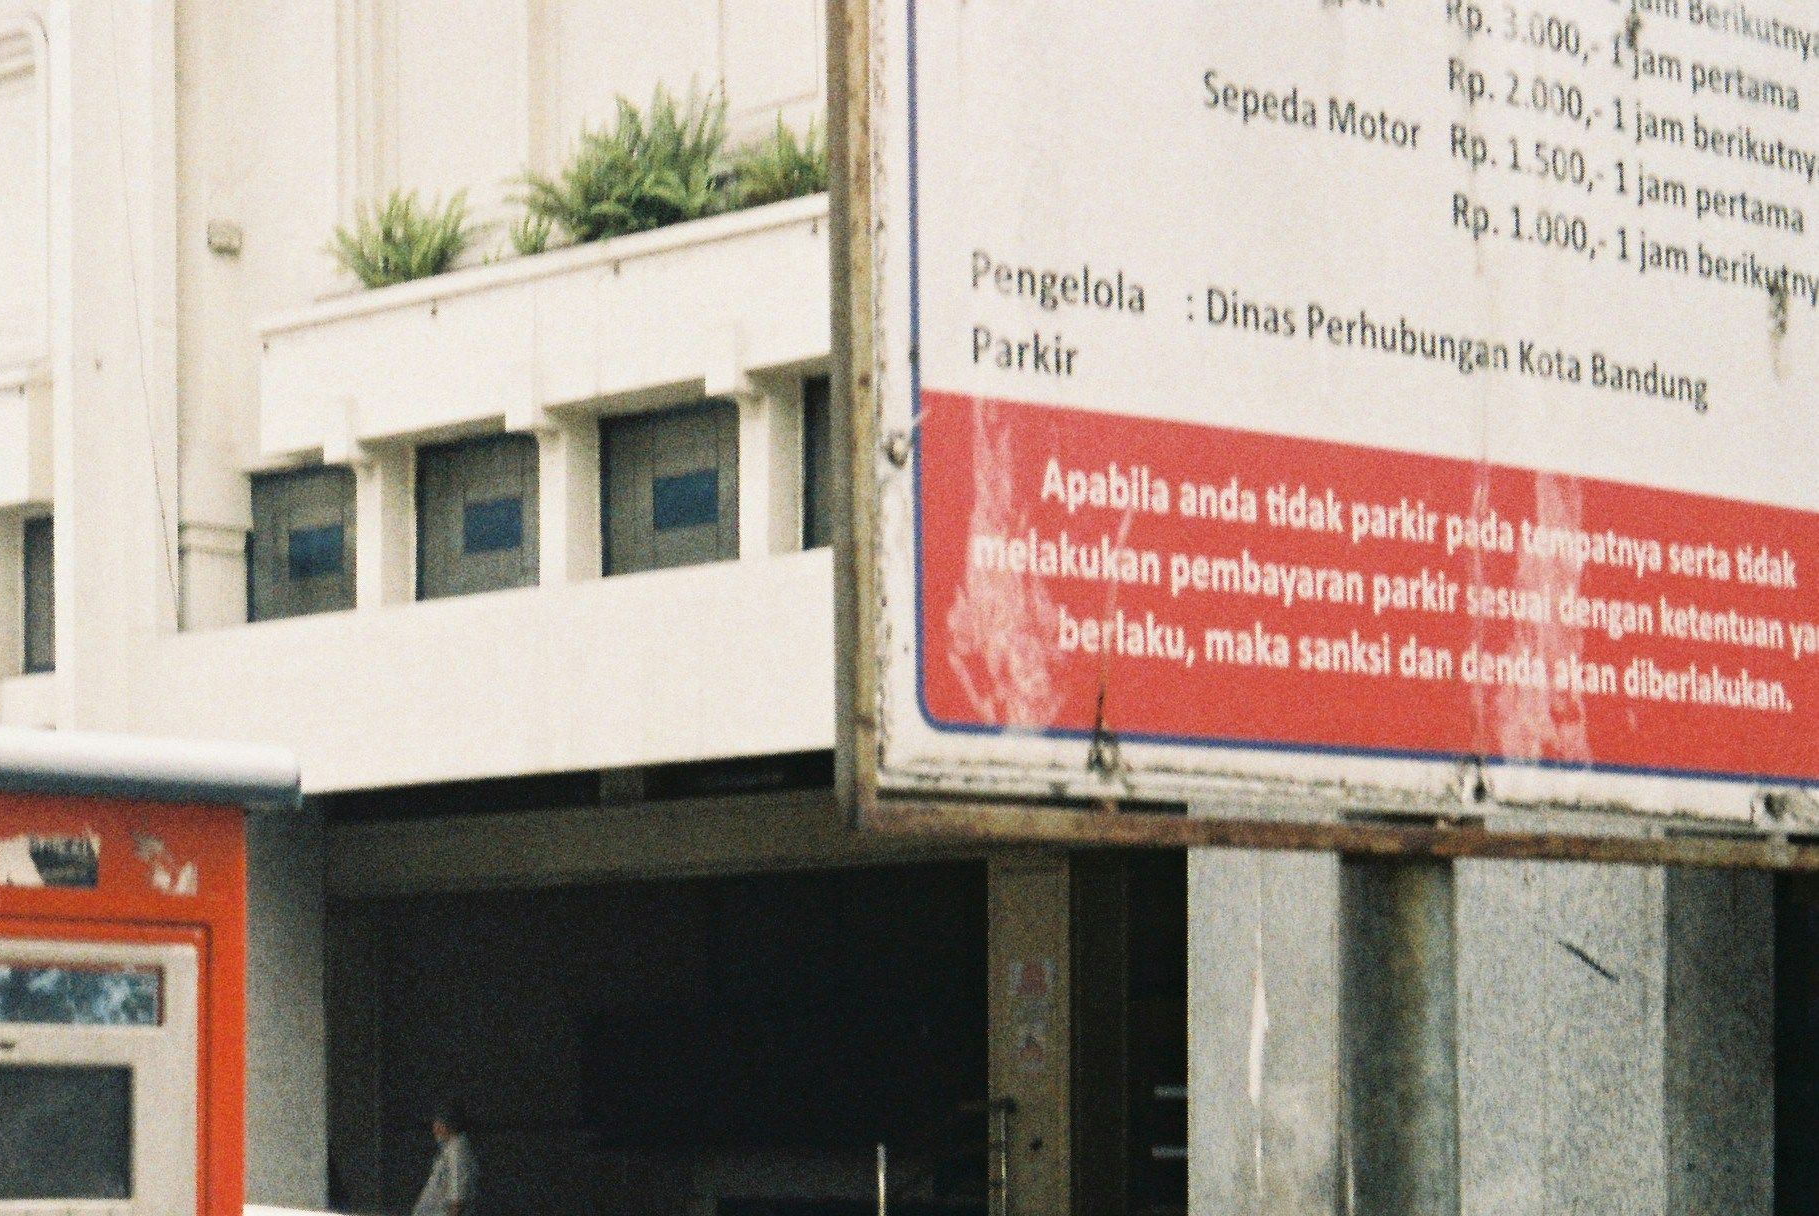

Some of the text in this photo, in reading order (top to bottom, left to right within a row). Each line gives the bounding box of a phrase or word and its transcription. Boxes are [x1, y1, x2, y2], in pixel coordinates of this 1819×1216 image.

[1448, 56, 1494, 106] Rp.
[1614, 96, 1624, 131] 1
[1636, 100, 1684, 145] jam
[1693, 113, 1819, 183] berikutny
[1691, 62, 1799, 112] pertama
[1204, 69, 1316, 128] Sepeda
[1328, 96, 1420, 149] Motor
[1450, 123, 1496, 171] Rp.
[1616, 160, 1626, 193] 1
[1637, 163, 1686, 207] jam
[1696, 188, 1804, 234] pertama
[1453, 192, 1498, 241] Rp.
[1618, 226, 1627, 261] 1
[1639, 229, 1688, 275] jam
[971, 250, 1145, 313] Pengelola
[1207, 286, 1295, 337] Dinas
[1308, 301, 1509, 375] Perhubungan
[1519, 340, 1581, 385] Kota
[1591, 351, 1708, 413] Bandung
[972, 326, 1078, 376] Parkir
[1041, 457, 1798, 590] Apabila anda tidak parkir pada tempatnya serta tidak
[971, 527, 1819, 661] melakukan pembayaran parkir sesuai dengan ketentuan ya
[1059, 607, 1793, 713] berlaku, maka sanksi dan denda akan diberlakukan.
